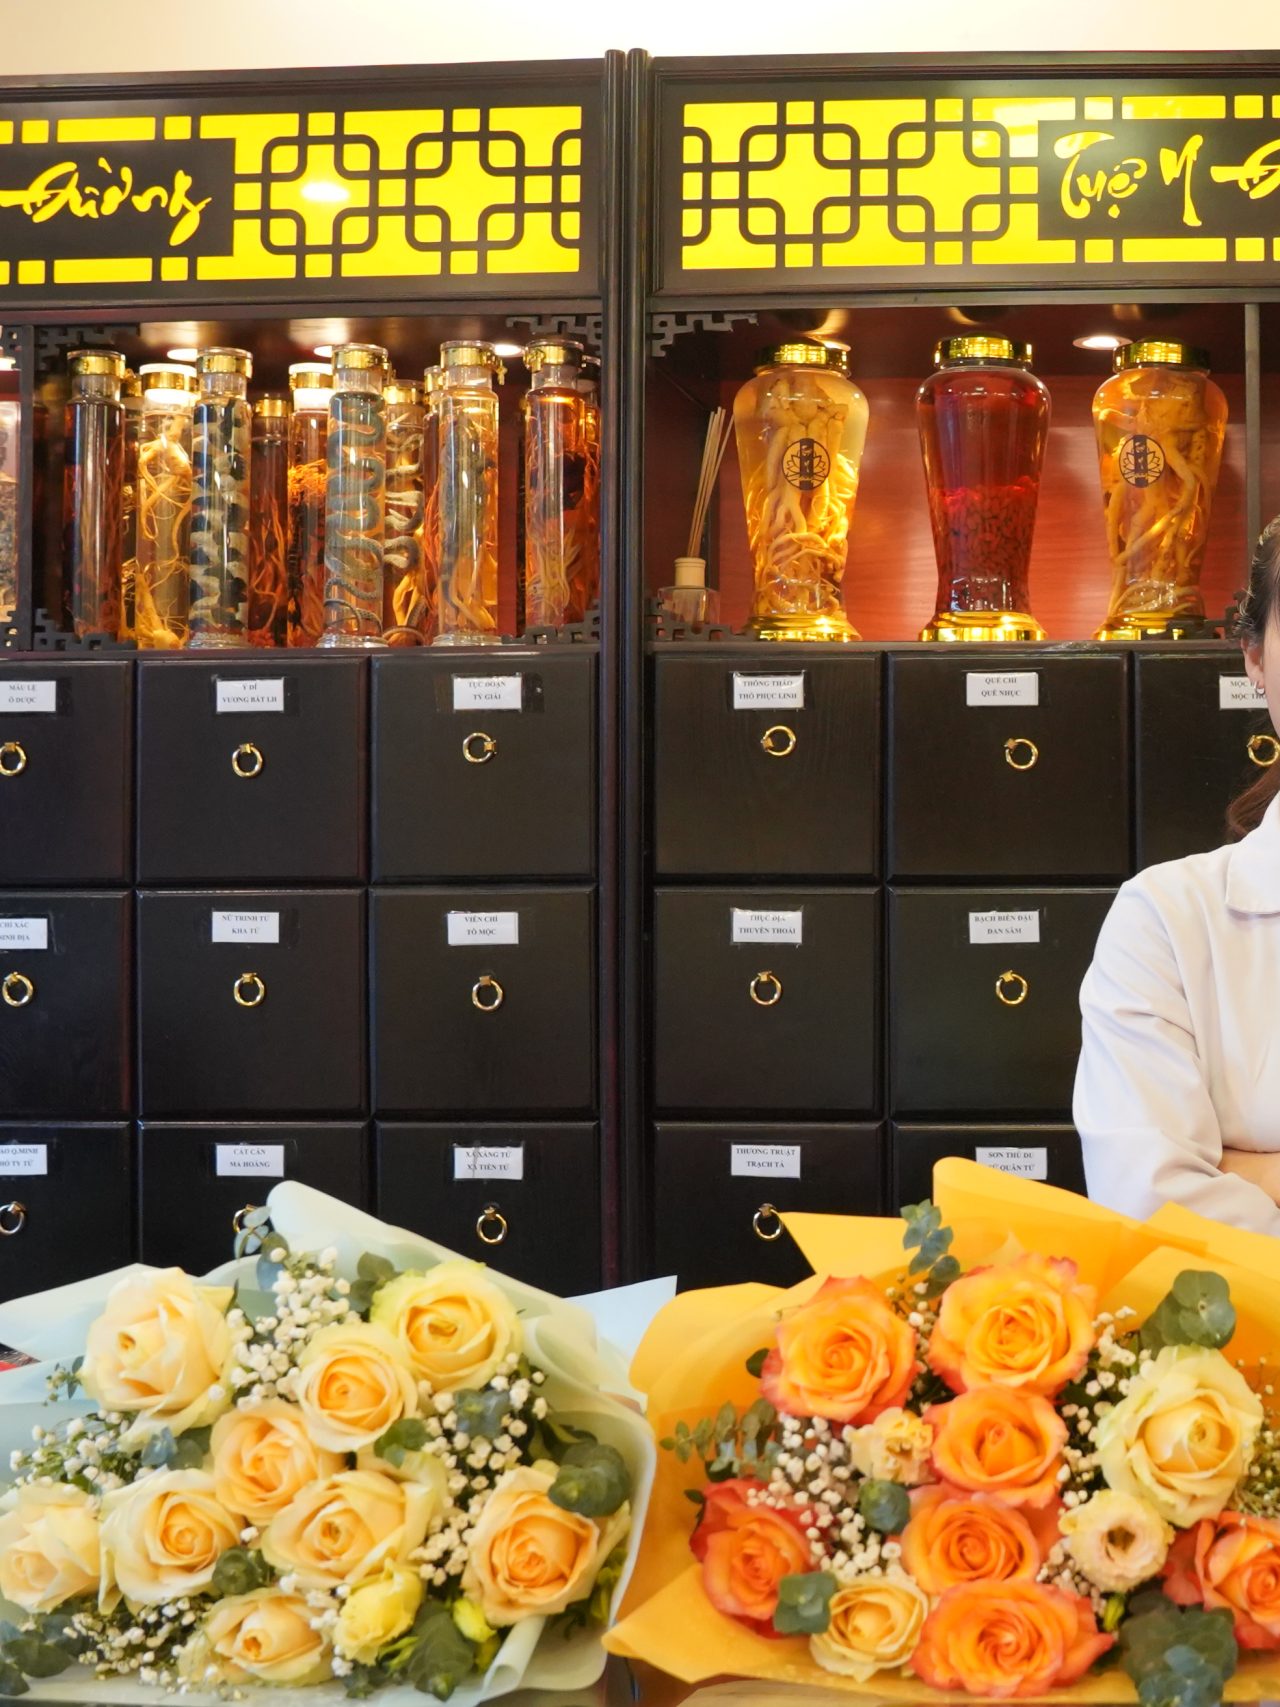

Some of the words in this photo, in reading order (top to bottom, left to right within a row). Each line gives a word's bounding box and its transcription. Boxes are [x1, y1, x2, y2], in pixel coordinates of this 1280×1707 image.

[1054, 131, 1148, 219] Tuệ
[743, 679, 770, 687] THÔNG
[1002, 676, 1017, 685] CHI
[756, 692, 777, 700] PHỤC
[778, 692, 797, 700] LINH
[999, 689, 1021, 697] NHỤC
[235, 914, 259, 922] TRINH
[975, 915, 996, 923] BẠCH
[478, 928, 496, 936] MỘC
[1005, 927, 1022, 935] SÂM
[736, 1147, 768, 1157] THƯƠNG
[988, 1151, 1004, 1159] SƠN
[747, 1159, 773, 1169] TRẠCH
[999, 1164, 1022, 1172] QUÂN
